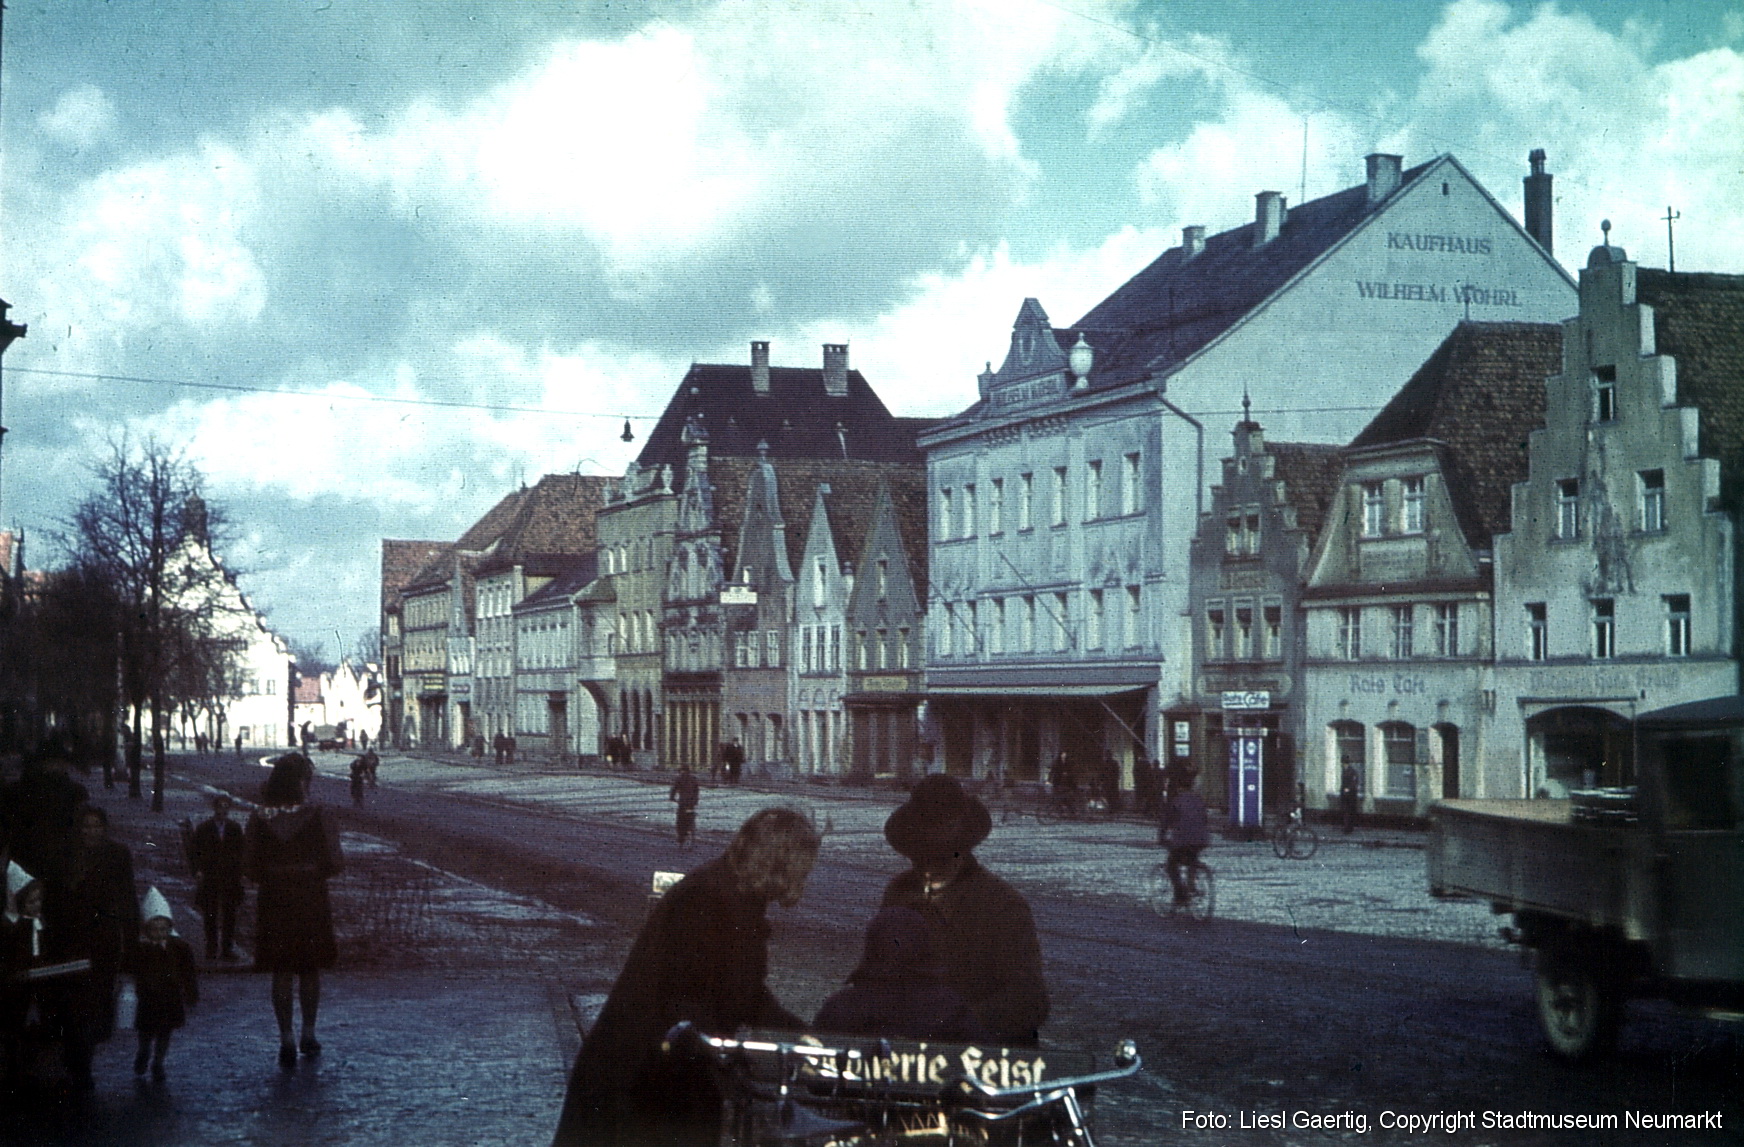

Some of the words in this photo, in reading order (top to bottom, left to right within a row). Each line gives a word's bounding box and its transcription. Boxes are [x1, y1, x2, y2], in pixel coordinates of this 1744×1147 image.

[1387, 232, 1491, 255] KAUFHAUS
[1356, 281, 1446, 303] WILHELM
[961, 1046, 1046, 1093] Feist
